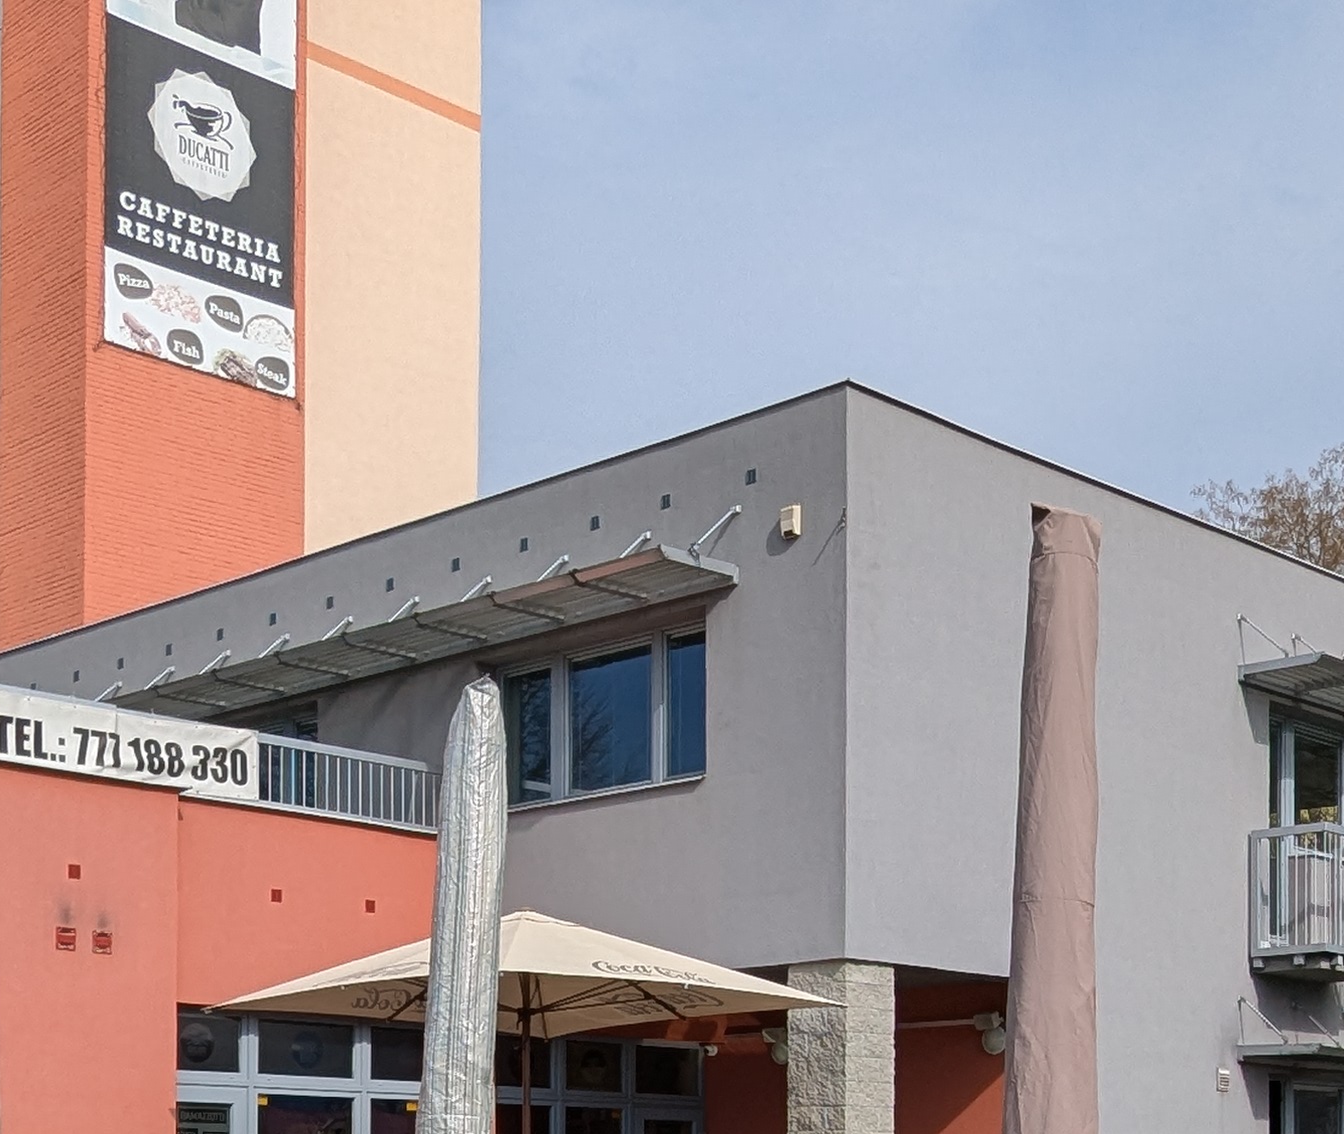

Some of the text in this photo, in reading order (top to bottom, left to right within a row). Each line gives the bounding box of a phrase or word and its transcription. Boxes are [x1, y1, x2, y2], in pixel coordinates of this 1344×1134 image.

[178, 134, 230, 172] DUCATTI
[119, 191, 282, 264] CAFFETERIA
[117, 214, 284, 288] RESTAURANT
[117, 272, 150, 290] Pizza
[208, 301, 241, 325] Pasta
[172, 339, 201, 360] Fish
[257, 362, 288, 386] Steak
[72, 727, 122, 768] 777
[127, 737, 186, 778] 188
[191, 745, 249, 786] 330
